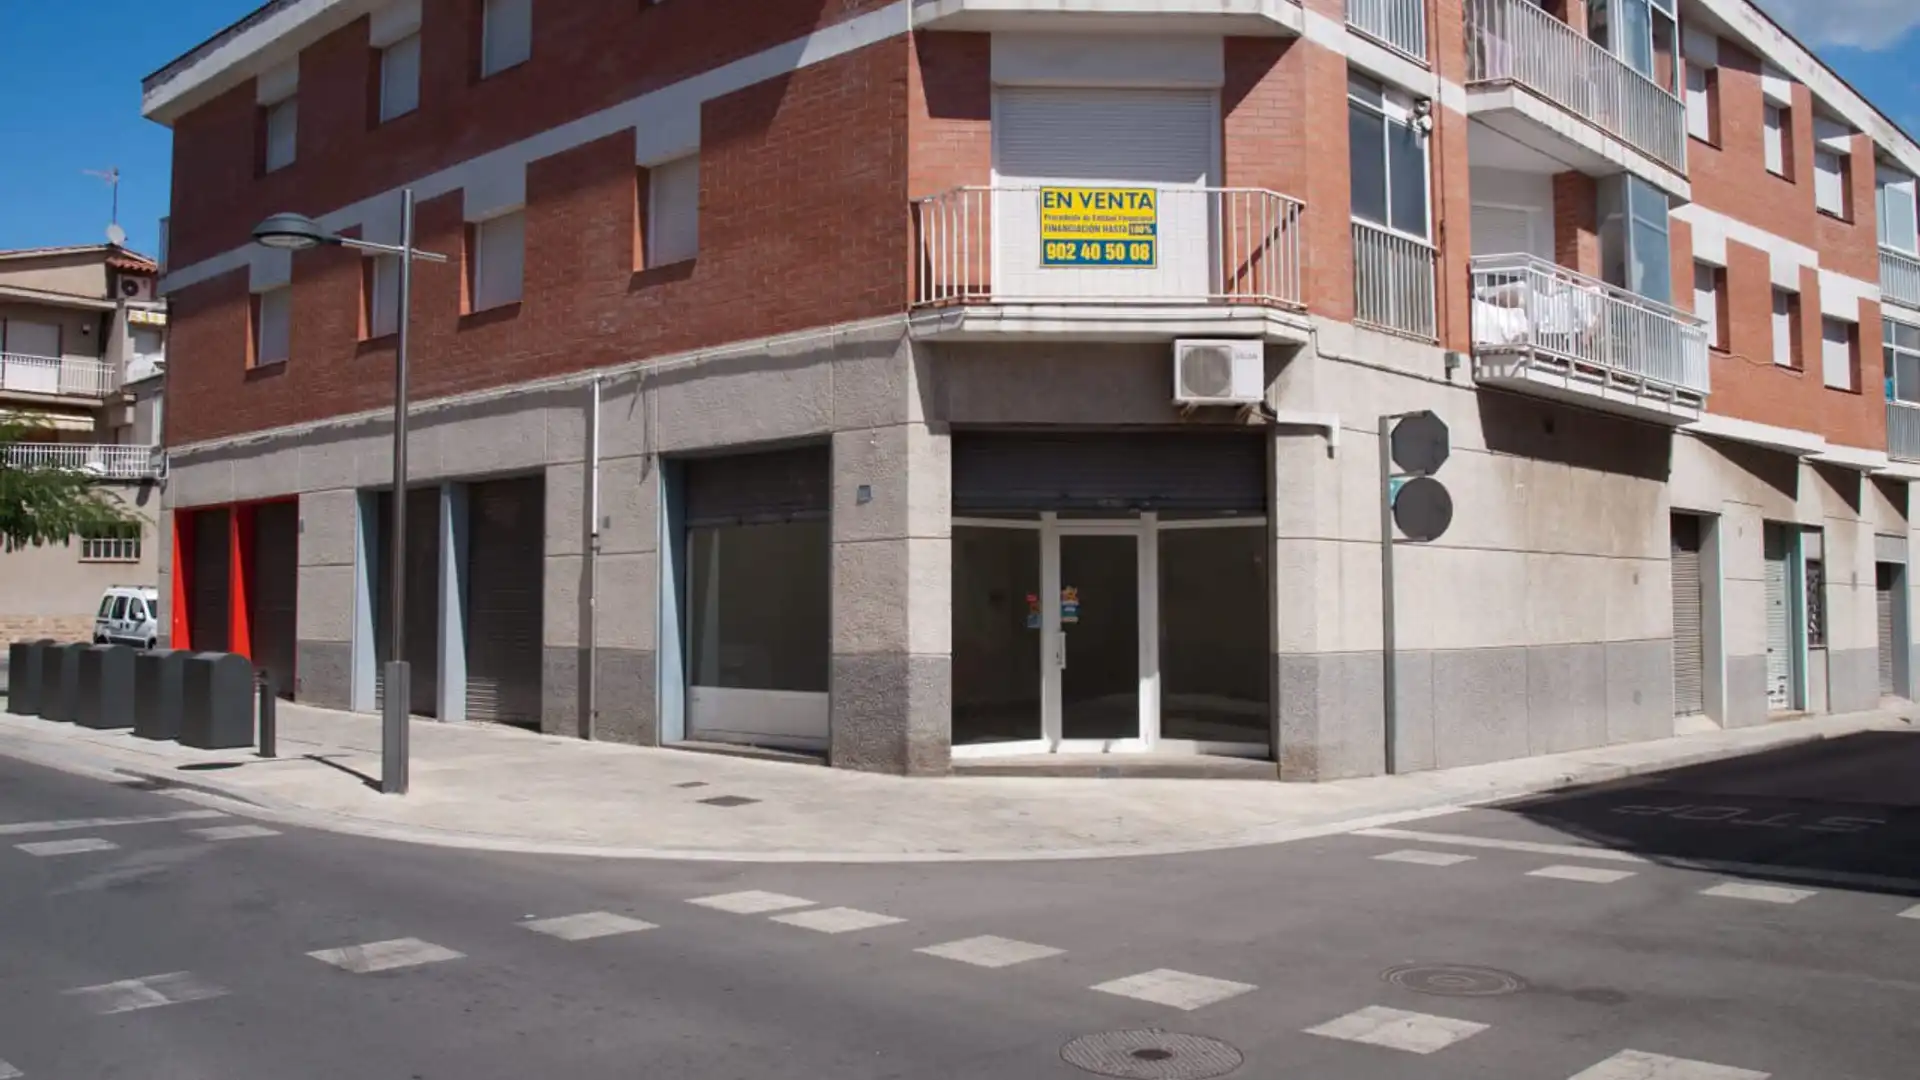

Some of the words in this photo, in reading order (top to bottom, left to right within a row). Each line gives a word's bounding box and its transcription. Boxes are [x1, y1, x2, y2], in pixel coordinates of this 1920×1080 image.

[1043, 191, 1072, 208] EN
[1078, 191, 1153, 209] VENTA
[1102, 224, 1127, 233] HASTA
[1046, 243, 1076, 260] 902
[1080, 243, 1101, 260] 40
[1105, 243, 1126, 260] 50
[1130, 243, 1150, 261] 08
[1609, 803, 1886, 832] STOP
